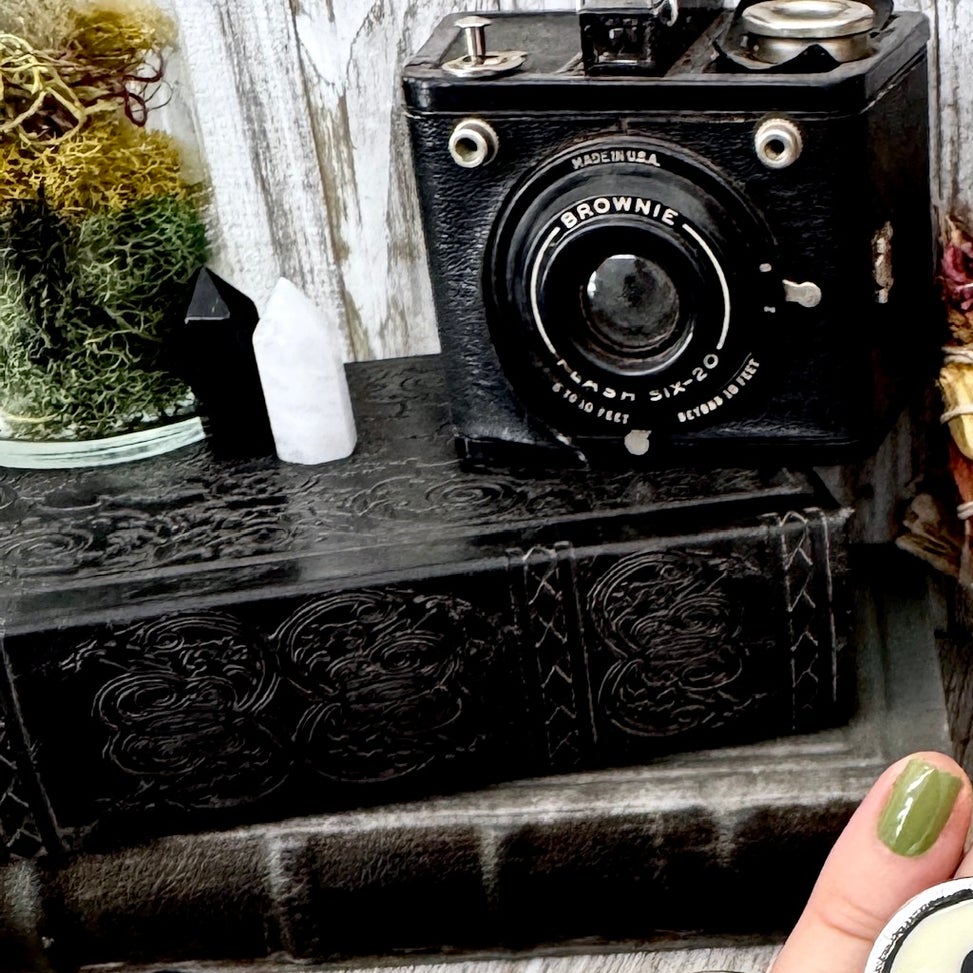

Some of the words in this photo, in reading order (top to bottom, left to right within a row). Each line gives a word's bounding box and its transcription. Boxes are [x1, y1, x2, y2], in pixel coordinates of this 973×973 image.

[571, 152, 611, 169] MADE
[610, 150, 625, 162] IN
[560, 196, 679, 229] BROWNIE
[648, 353, 719, 402] SIX-20
